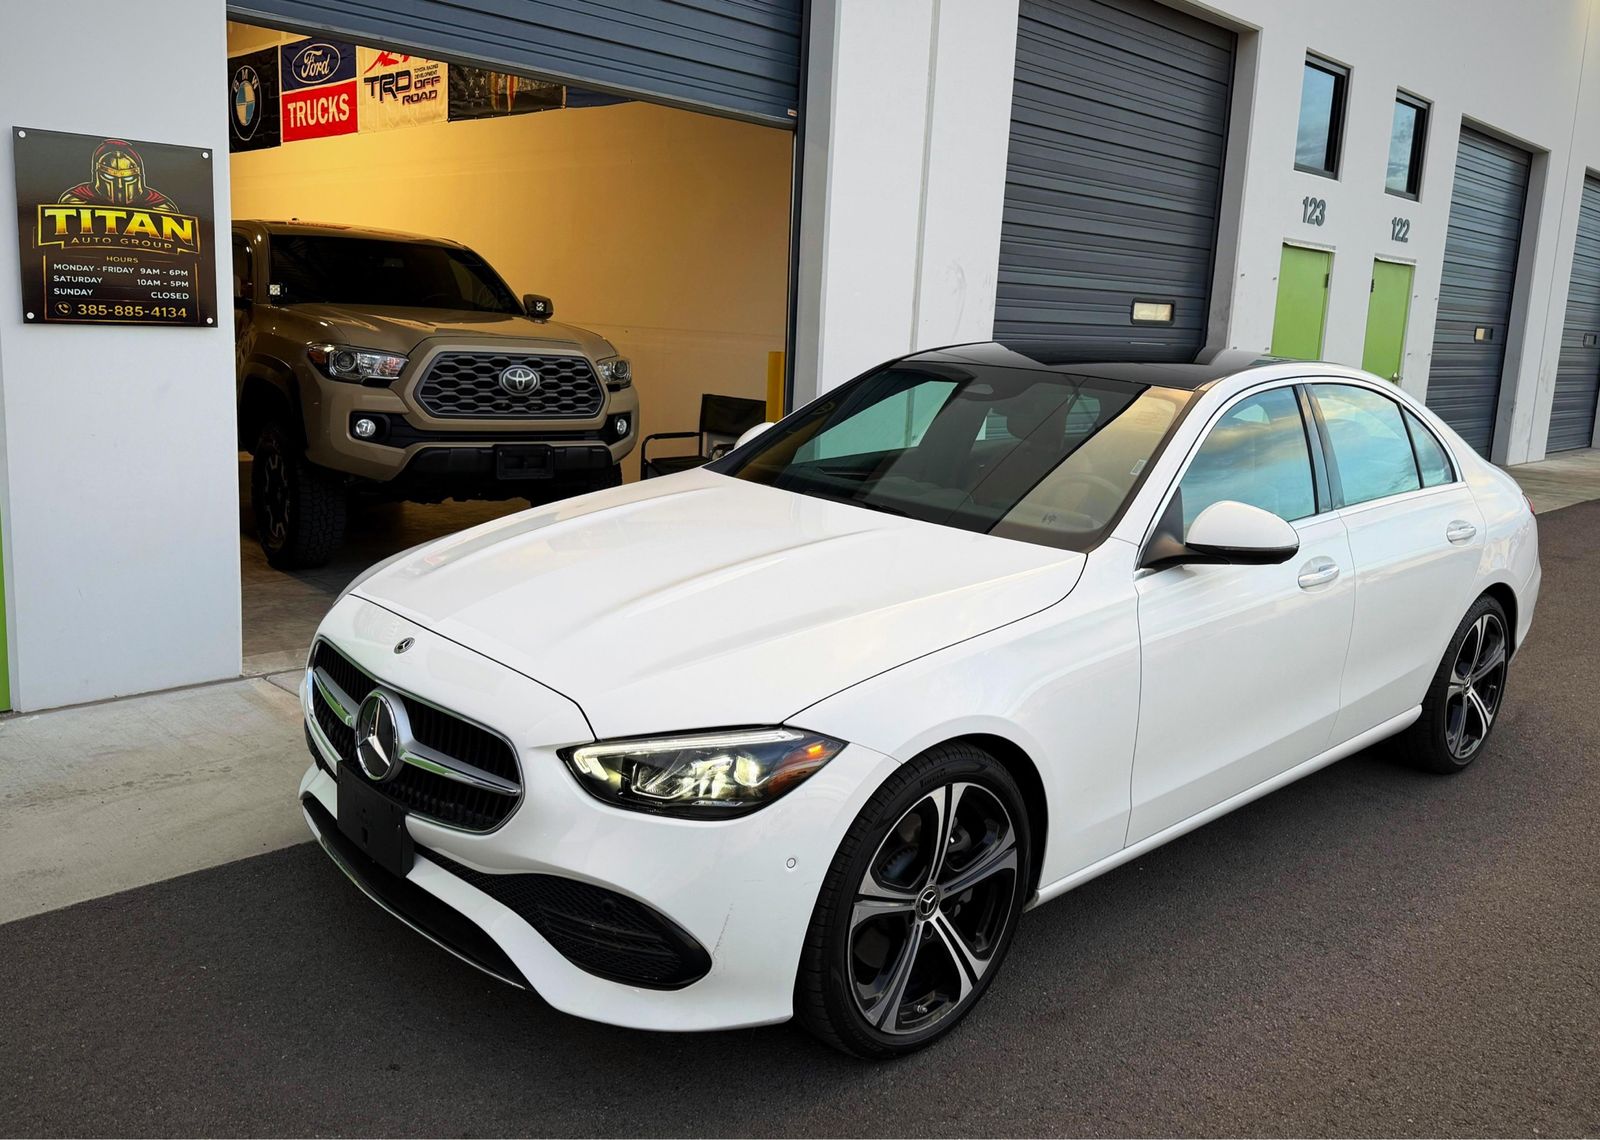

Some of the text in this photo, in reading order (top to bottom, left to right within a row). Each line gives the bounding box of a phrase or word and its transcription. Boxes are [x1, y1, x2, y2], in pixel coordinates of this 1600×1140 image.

[301, 50, 331, 78] Ford
[364, 70, 412, 103] TRD
[414, 76, 441, 90] OFF
[402, 90, 438, 105] ROAD
[287, 93, 350, 128] TRUCKS
[1302, 196, 1327, 227] 123
[44, 208, 194, 246] TITAN
[1391, 216, 1411, 243] 122
[120, 238, 173, 249] GROUP
[106, 255, 139, 264] HOURS
[53, 263, 95, 272] MONDAY
[102, 265, 135, 274] FRIDAY
[139, 267, 160, 275] 9AM
[169, 269, 189, 277] 6PM
[53, 275, 103, 284] SATURDAY
[137, 278, 161, 287] 10AM
[170, 280, 189, 288] 5PM
[53, 287, 190, 300] SUNDAY CLOSED
[77, 303, 188, 318] 385-885-4134
